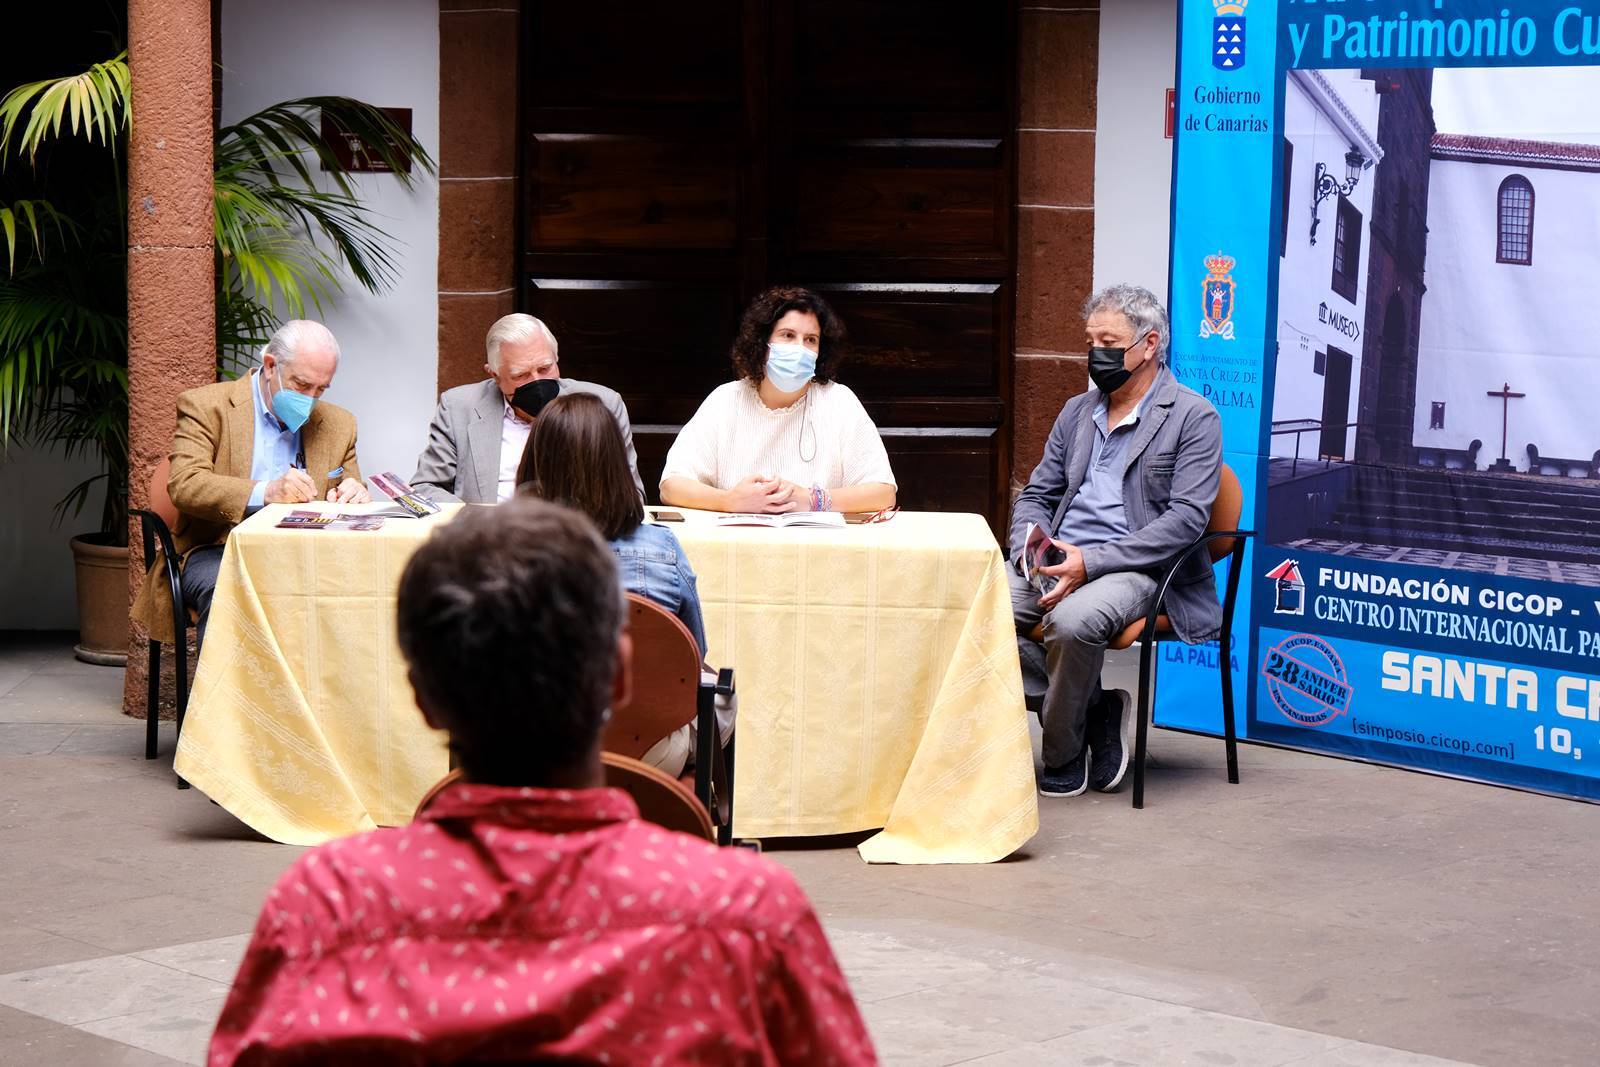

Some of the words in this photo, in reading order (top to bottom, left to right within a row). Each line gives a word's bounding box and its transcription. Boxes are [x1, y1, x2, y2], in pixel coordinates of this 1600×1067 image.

[1288, 23, 1310, 68] y
[1323, 9, 1537, 58] Patrimonio
[1194, 86, 1261, 104] Gobierno
[1185, 114, 1200, 131] de
[1205, 114, 1269, 132] Canarias
[1328, 308, 1355, 338] MUSEO
[1175, 363, 1208, 380] SANTA
[1211, 366, 1240, 383] CRUZ
[1243, 371, 1257, 383] DE
[1203, 383, 1255, 409] PALMA
[1319, 567, 1470, 606] FUNDACIÓN
[1479, 588, 1563, 617] CICOP
[1314, 594, 1395, 629] CENTRO
[1398, 606, 1574, 654] INTERNACIONAL
[1165, 645, 1184, 663] LA
[1188, 648, 1240, 673] PALA
[1266, 653, 1299, 684] 28
[1301, 669, 1347, 699] ANIVER
[1381, 650, 1539, 712] SANTA
